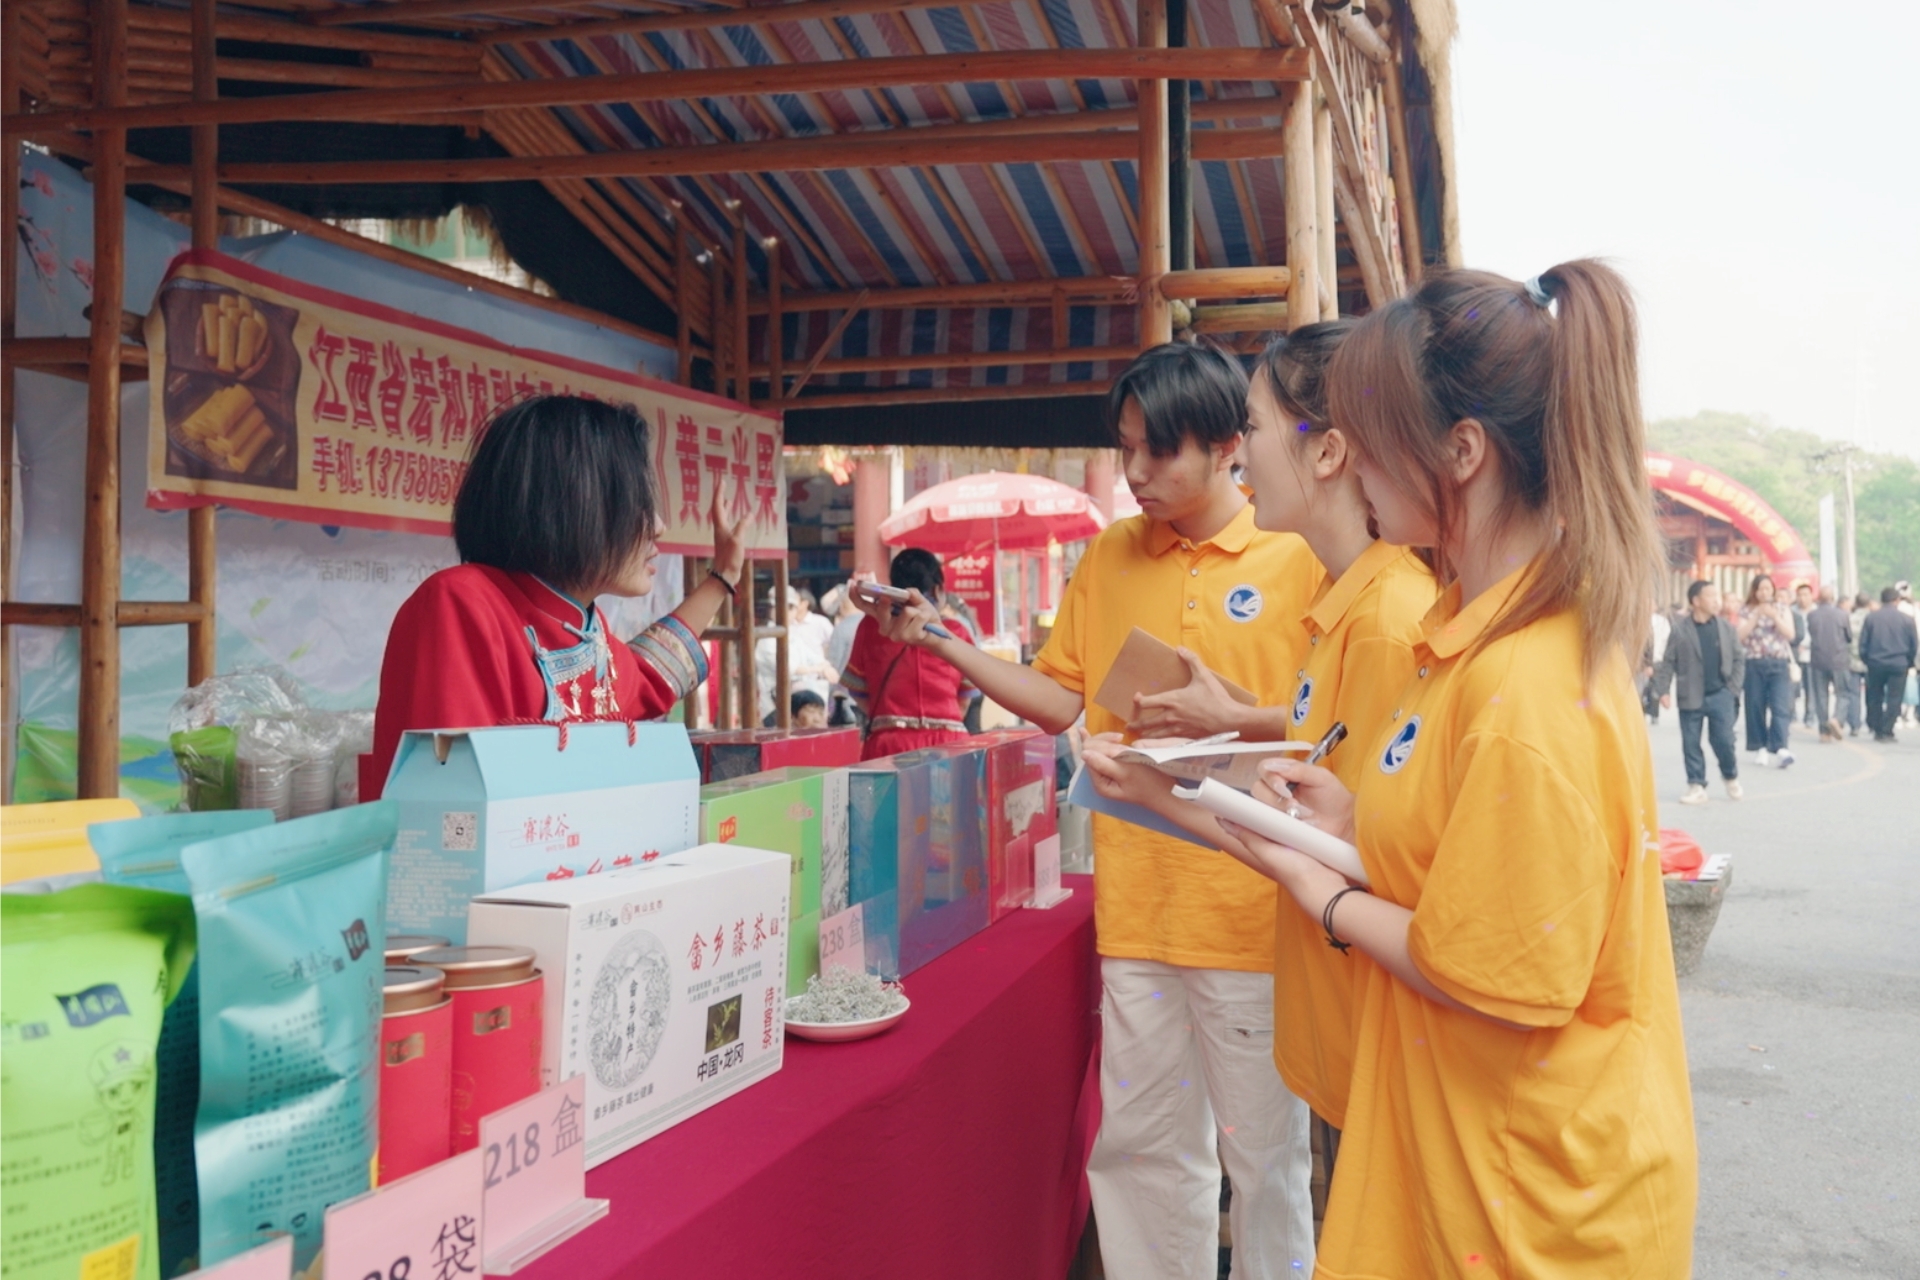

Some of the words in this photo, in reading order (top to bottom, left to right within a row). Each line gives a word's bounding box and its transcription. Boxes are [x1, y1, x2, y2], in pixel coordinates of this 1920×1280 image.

[821, 926, 845, 960] 238
[848, 912, 863, 948] 盒
[485, 1121, 541, 1190] 218
[551, 1093, 583, 1158] 盒
[430, 1214, 478, 1280] 袋
